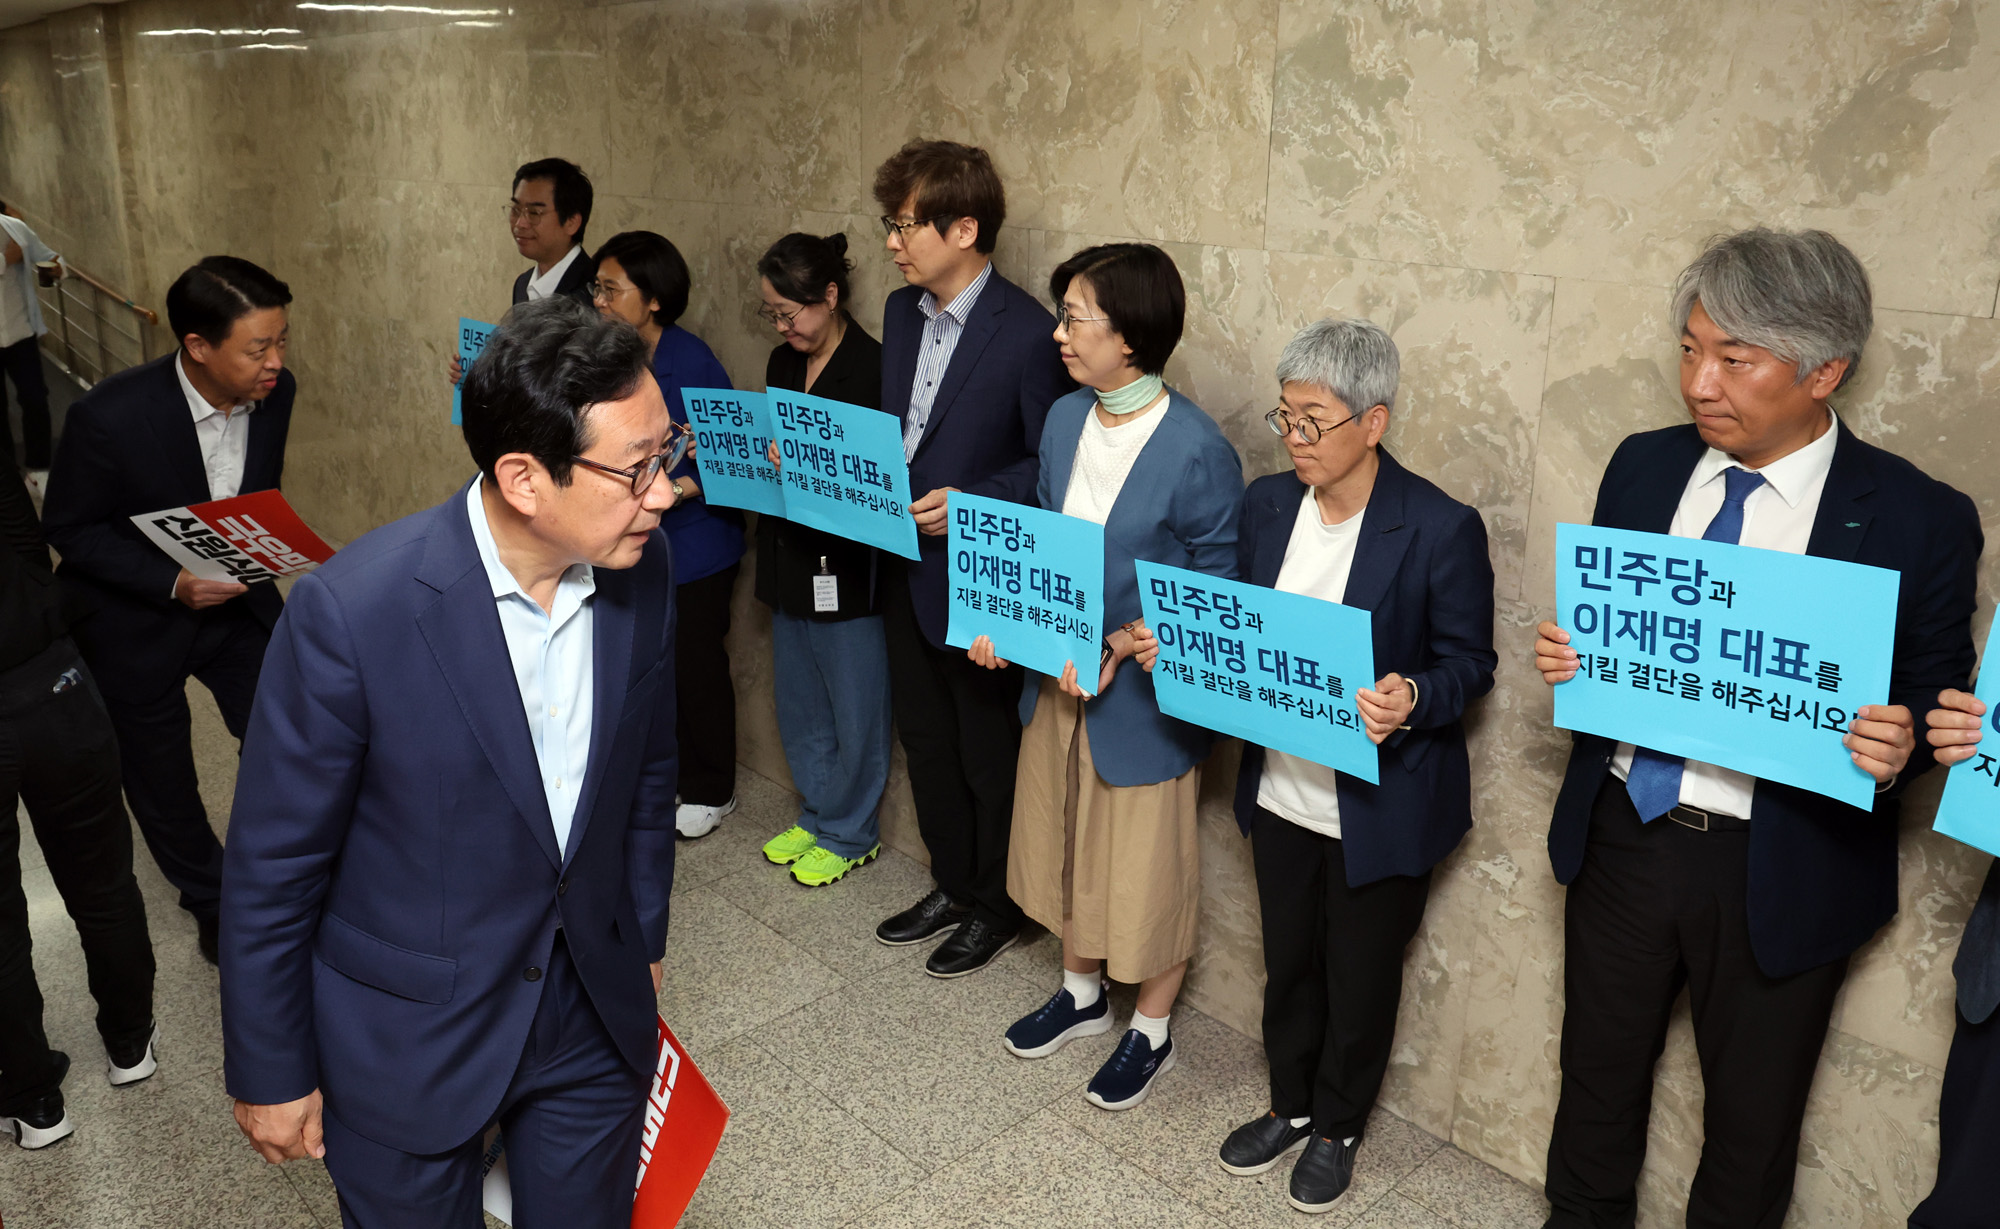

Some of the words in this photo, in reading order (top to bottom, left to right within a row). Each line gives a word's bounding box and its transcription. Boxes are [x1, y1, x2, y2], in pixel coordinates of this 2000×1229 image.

[691, 398, 754, 427] 민주당과
[776, 401, 845, 442] 민주당과
[699, 431, 750, 460] 이재명
[753, 436, 775, 463] 대
[704, 459, 724, 476] 지킬
[726, 461, 755, 480] 결단을
[782, 438, 838, 478] 이재명
[842, 454, 893, 493] 대표를
[787, 471, 810, 491] 지킬
[810, 478, 844, 501] 결단을
[844, 486, 905, 520] 해주십시오!
[956, 507, 1036, 553] 민주당과
[957, 550, 1022, 595] 이재명
[1029, 567, 1086, 612] 대표를
[1574, 545, 1737, 609] 민주당과
[956, 587, 982, 611] 지킬
[986, 593, 1024, 622] 결단을
[1027, 605, 1094, 644] 해주십시오!
[1150, 577, 1264, 634] 민주당과
[1157, 622, 1247, 674] 이재명
[1257, 647, 1345, 699] 대표를
[1573, 602, 1703, 665] 이재명
[1719, 627, 1843, 693] 대표를
[1161, 659, 1196, 685] 지킬
[1199, 668, 1253, 702] 결단을
[1257, 685, 1360, 732] 해주십시오!
[1577, 653, 1619, 684] 지킬
[1627, 660, 1704, 702] 결단을
